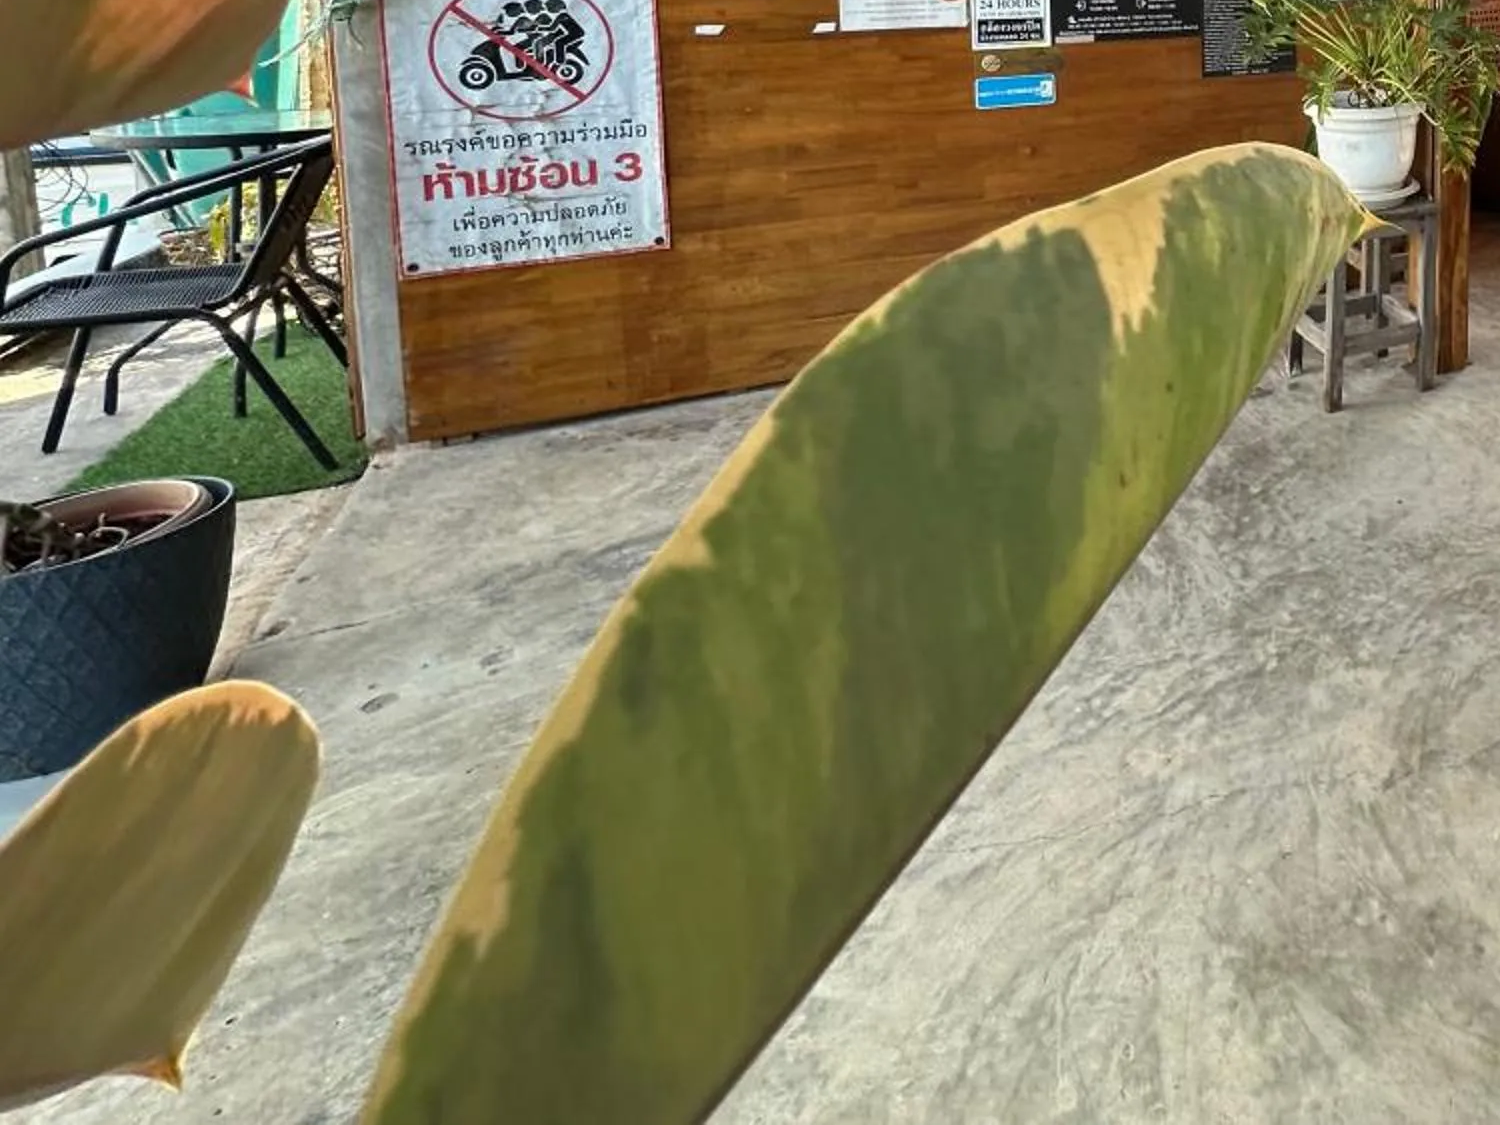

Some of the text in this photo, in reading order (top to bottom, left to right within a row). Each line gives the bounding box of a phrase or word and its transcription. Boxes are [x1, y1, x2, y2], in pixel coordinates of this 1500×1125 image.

[979, 0, 993, 10] 24
[423, 151, 643, 202] ห้ามซ้อน 3
[453, 196, 627, 232] เพื่อความปลอดภัย
[448, 223, 633, 260] ของลูกค้าทุกท่านค่ะ
